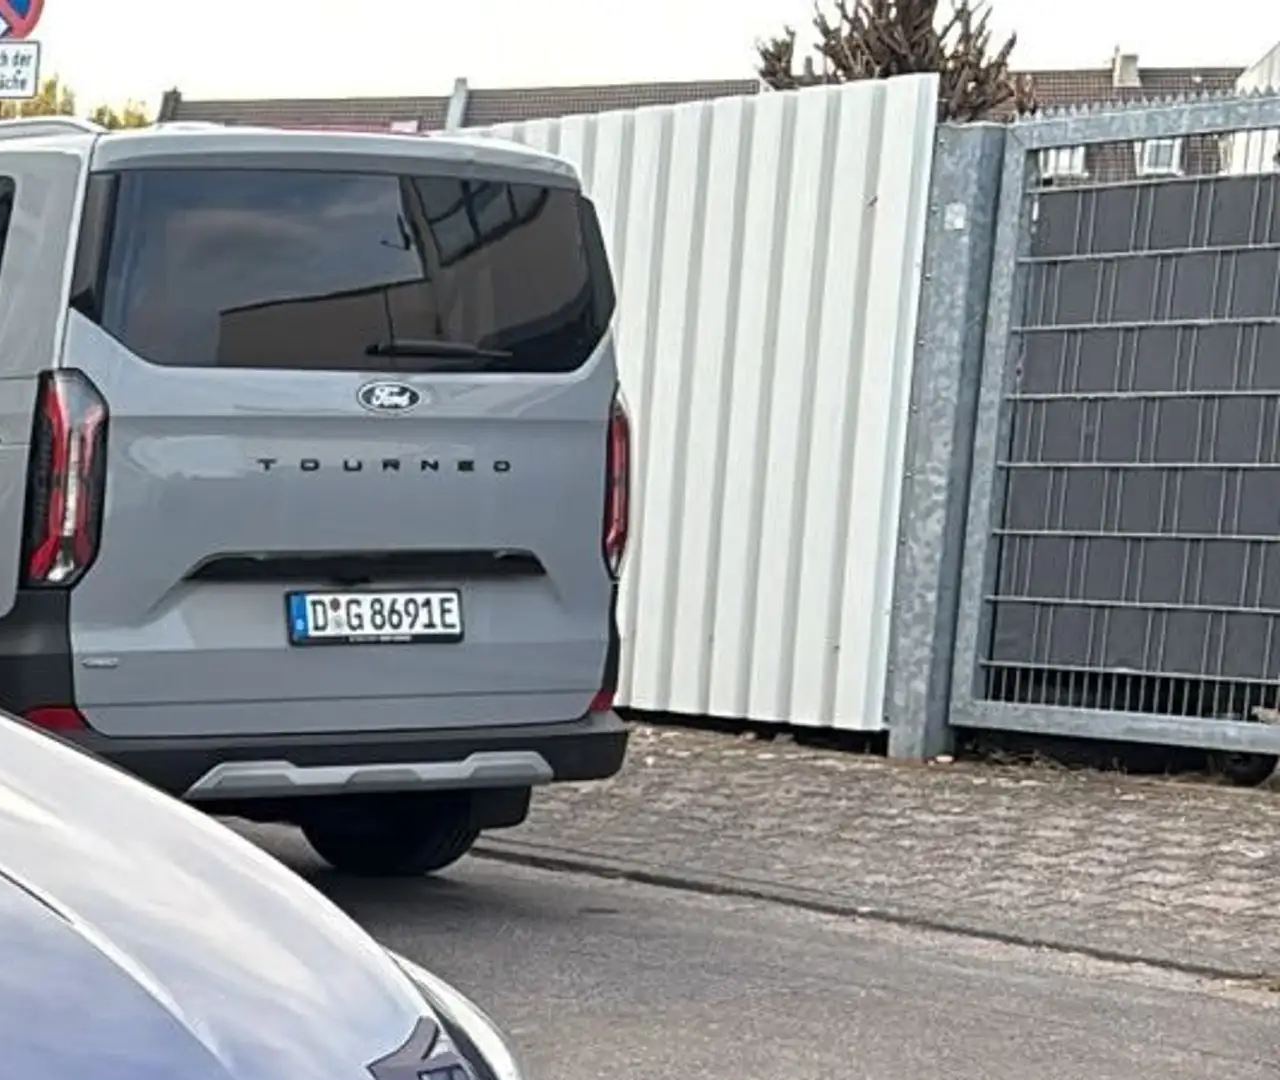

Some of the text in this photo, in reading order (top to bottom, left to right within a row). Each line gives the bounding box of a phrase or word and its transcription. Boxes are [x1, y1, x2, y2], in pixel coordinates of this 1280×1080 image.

[12, 50, 32, 67] der
[257, 459, 511, 472] TOURNEO
[311, 597, 457, 632] D G 8691E
